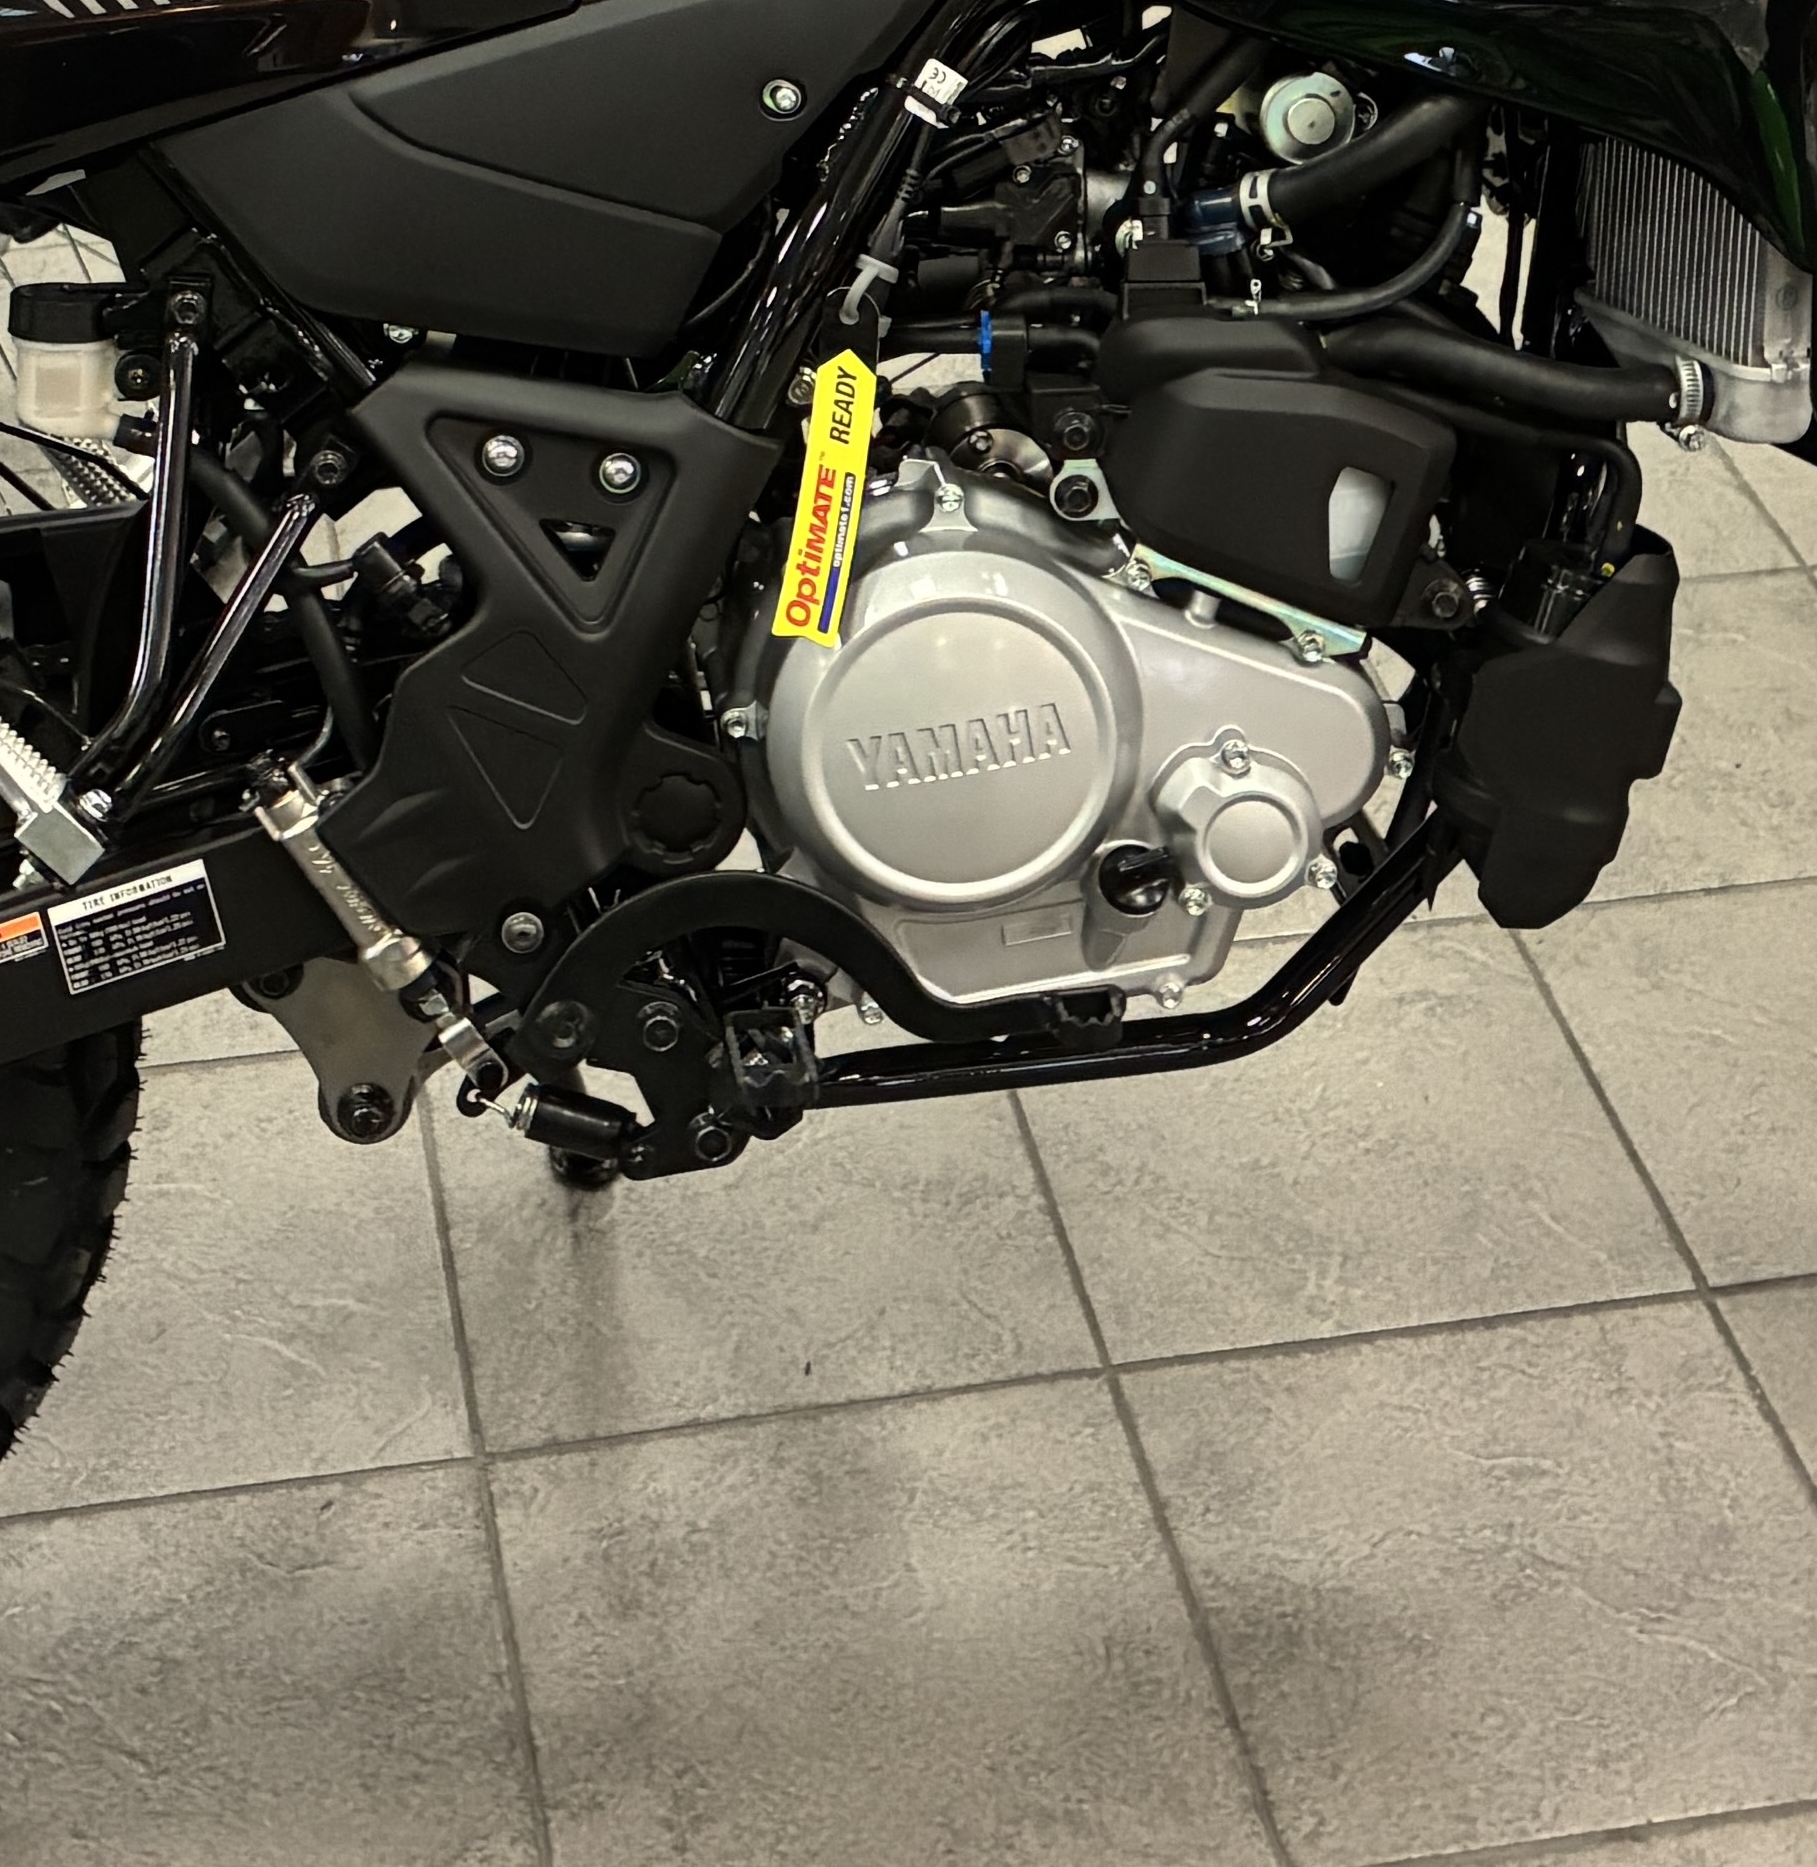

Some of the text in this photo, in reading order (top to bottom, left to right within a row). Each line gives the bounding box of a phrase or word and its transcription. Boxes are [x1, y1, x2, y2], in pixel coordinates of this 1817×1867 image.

[829, 365, 859, 446] READY
[845, 702, 1073, 792] YAMAHA
[82, 874, 174, 911] TIRE INFORMATION
